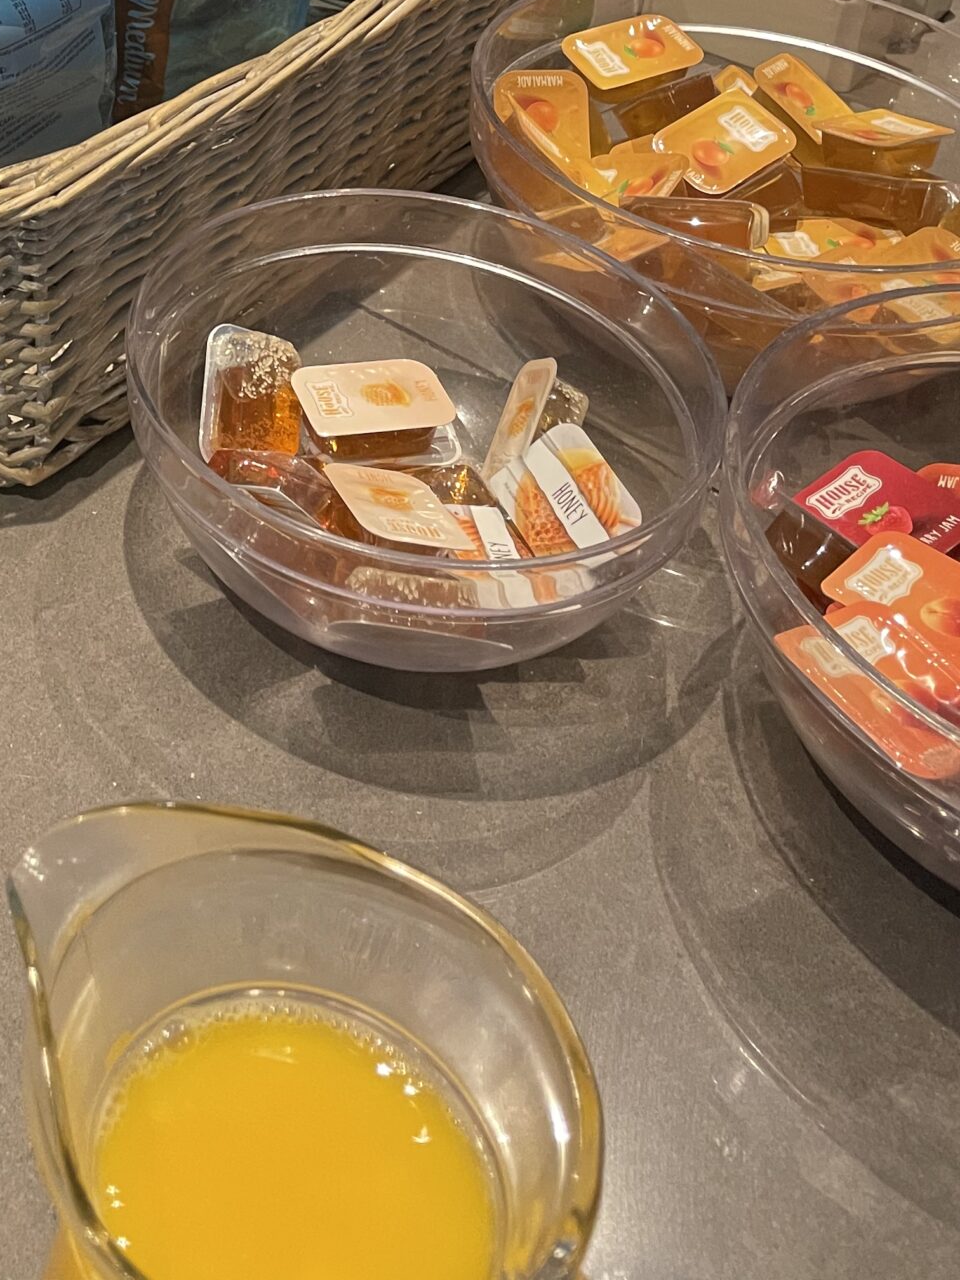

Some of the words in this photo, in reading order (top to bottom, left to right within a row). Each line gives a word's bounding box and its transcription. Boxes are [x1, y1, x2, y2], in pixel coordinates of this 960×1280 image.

[516, 75, 564, 89] MARMALADE
[938, 474, 960, 489] JAM
[814, 473, 868, 510] HOUSE
[552, 481, 588, 526] HONEY
[939, 514, 960, 533] JAM
